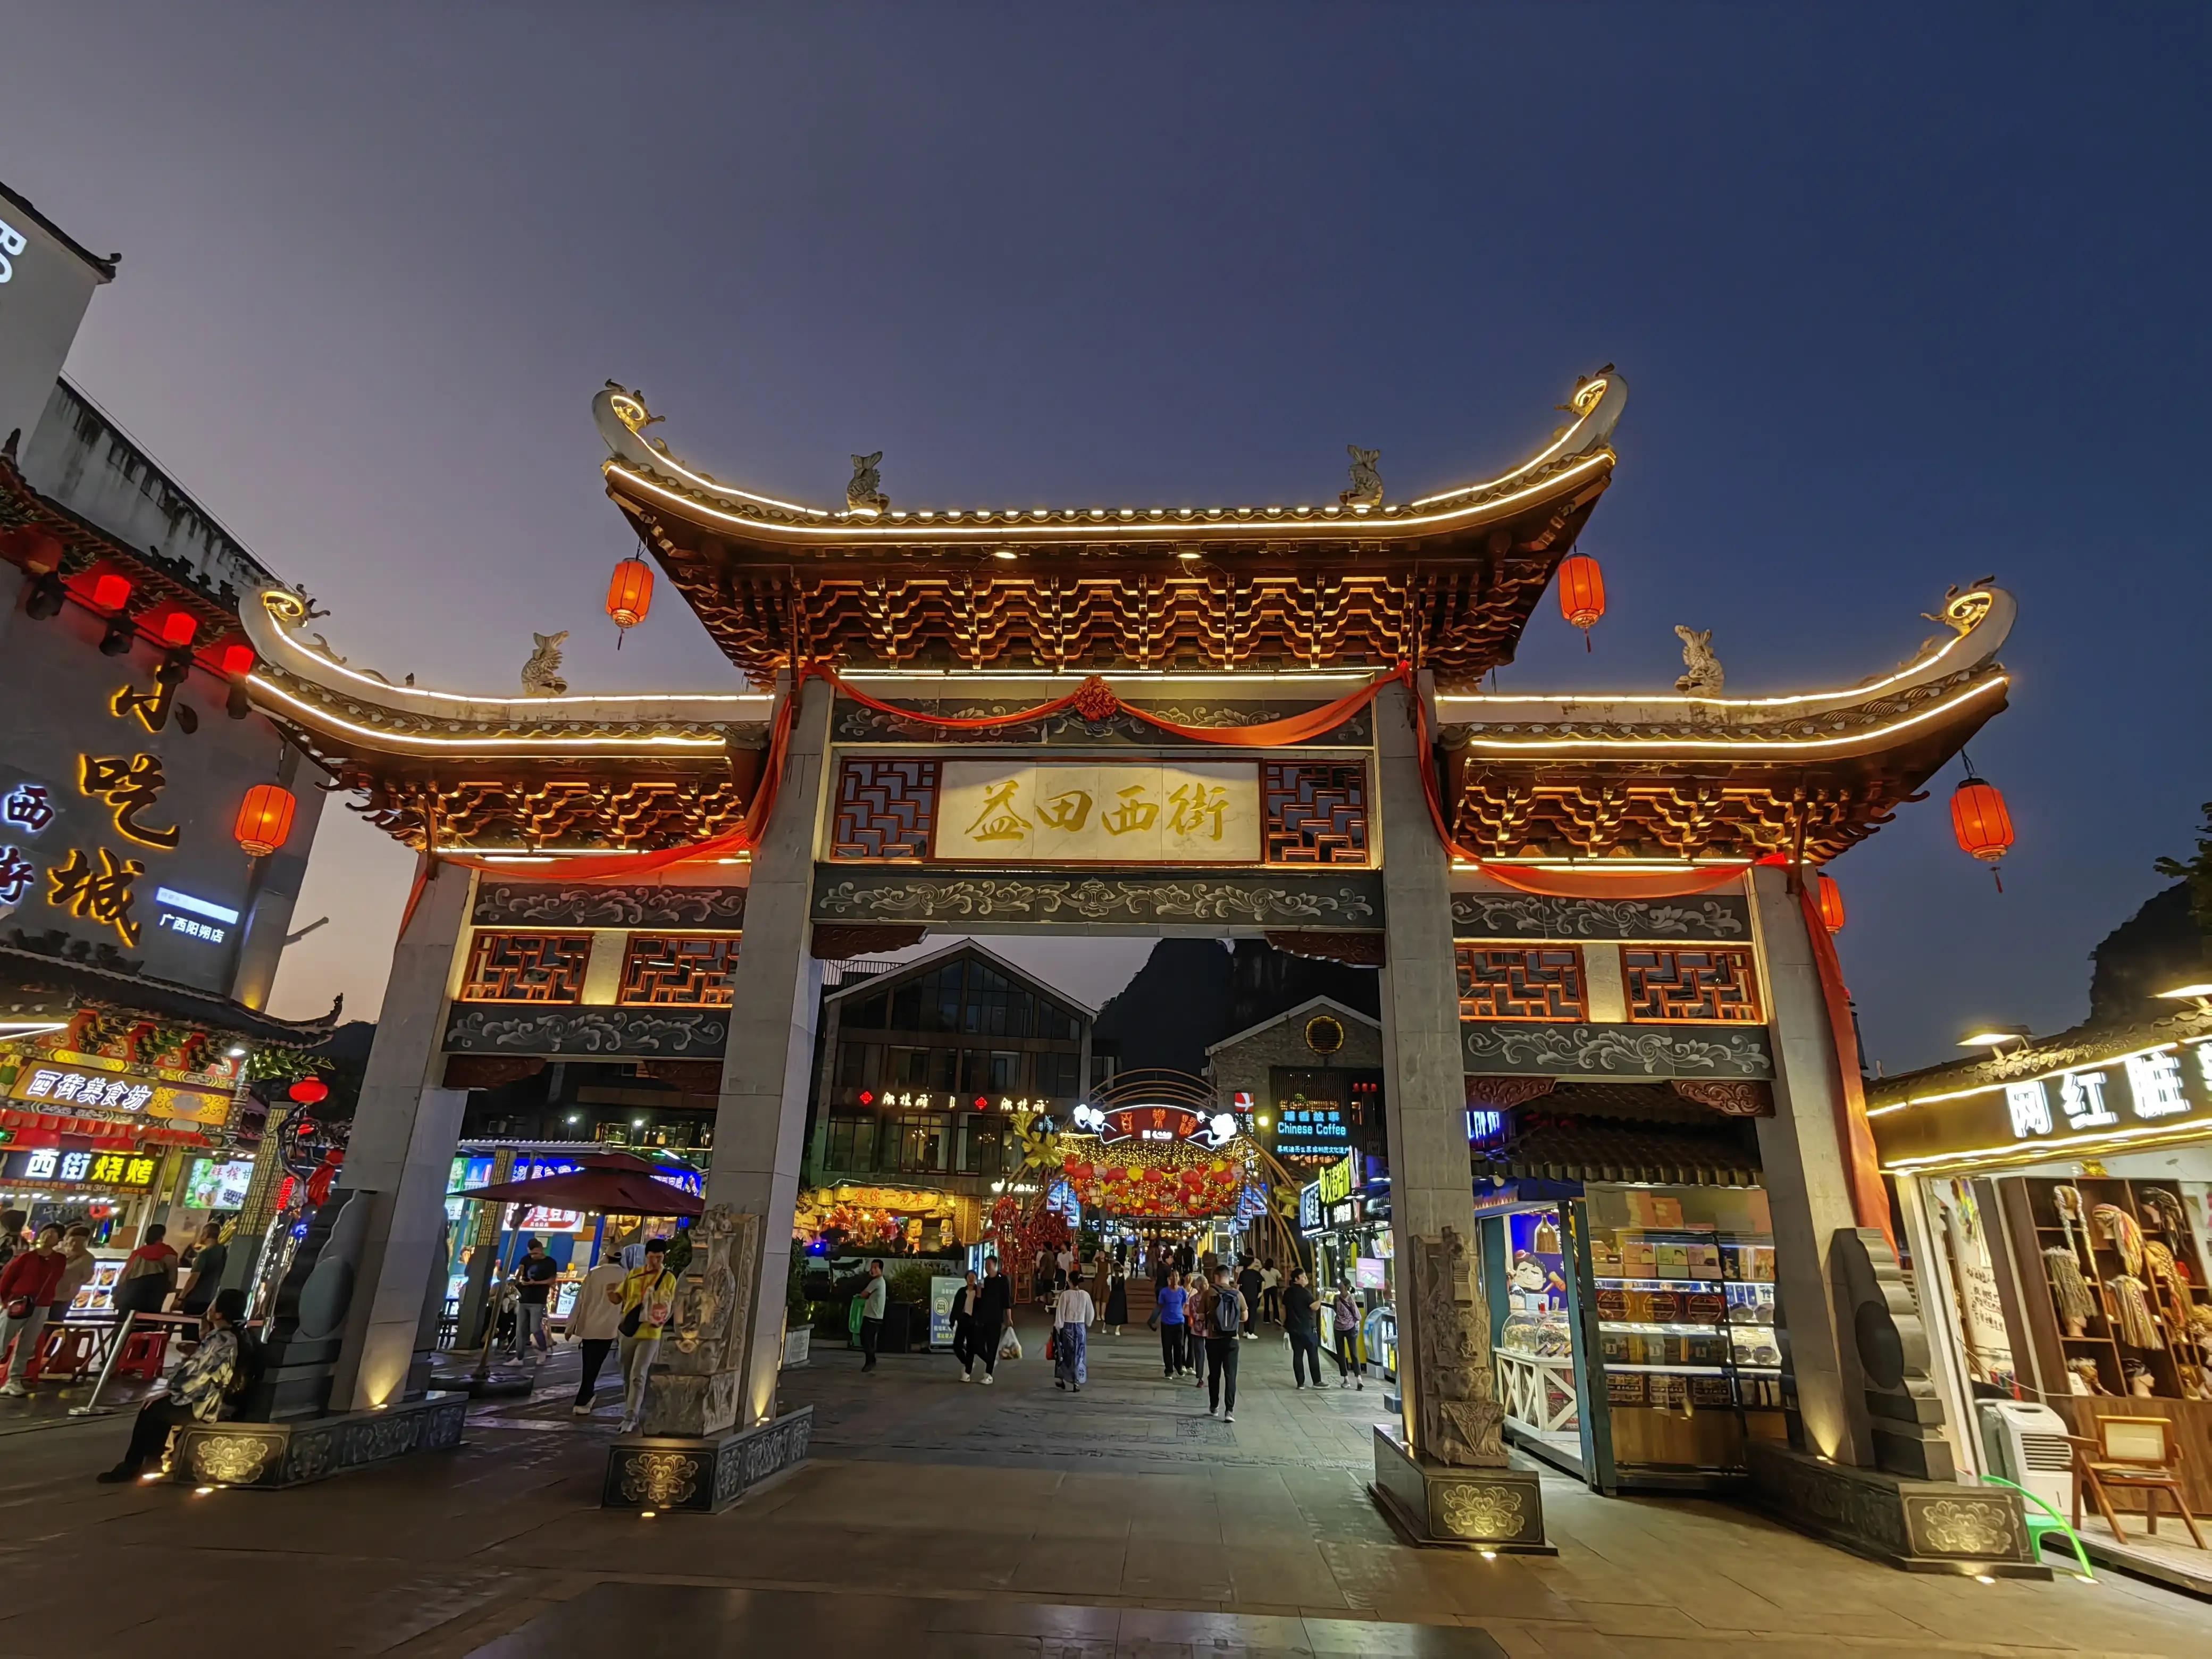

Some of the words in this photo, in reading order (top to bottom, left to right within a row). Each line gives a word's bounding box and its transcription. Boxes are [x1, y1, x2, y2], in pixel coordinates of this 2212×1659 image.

[964, 779, 1229, 843] 益田西街
[160, 914, 225, 943] 广西阳朔店
[27, 1069, 153, 1111] 西街美食坊
[2005, 1042, 2212, 1138] 网红脏
[1278, 1121, 1312, 1134] Chinese
[1316, 1123, 1346, 1135] Coffee
[25, 1149, 155, 1184] 西街烧烤
